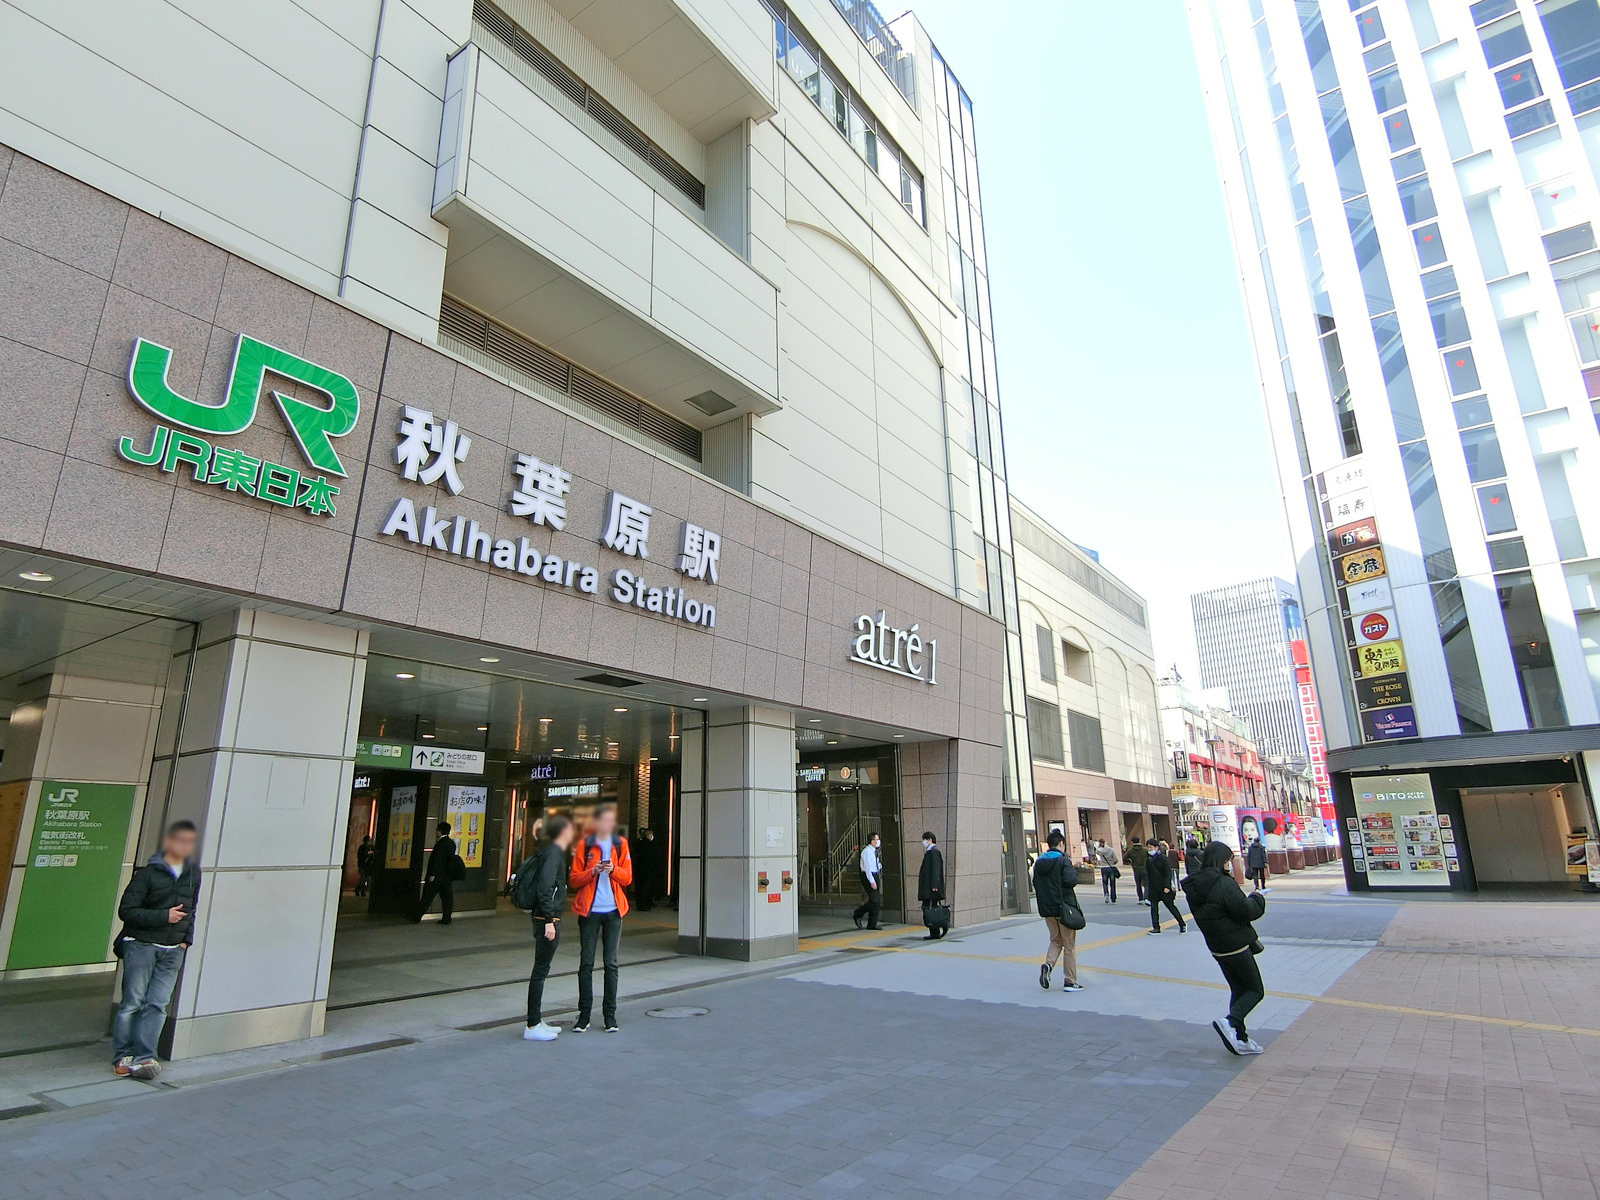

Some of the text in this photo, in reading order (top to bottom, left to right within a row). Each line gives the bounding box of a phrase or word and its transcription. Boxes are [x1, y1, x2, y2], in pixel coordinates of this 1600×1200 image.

[126, 332, 361, 479] JR
[115, 424, 340, 518] JR東日本
[395, 404, 722, 586] 秋葉原駅
[379, 497, 716, 628] Akihabara Station
[1347, 557, 1380, 577] 金の蔵
[1364, 622, 1387, 635] ガスト
[852, 609, 924, 676] atré
[1371, 682, 1403, 693] THE ROSE
[1376, 695, 1402, 705] CROWN
[446, 752, 478, 761] みどりの窓口
[530, 764, 551, 778] atré
[48, 788, 79, 803] JR
[548, 783, 599, 797] SARUTAHIKO COFFEE
[44, 809, 91, 821] 秋葉原駅
[43, 820, 103, 829] Akihabara Station
[40, 830, 87, 840] 電気街改札
